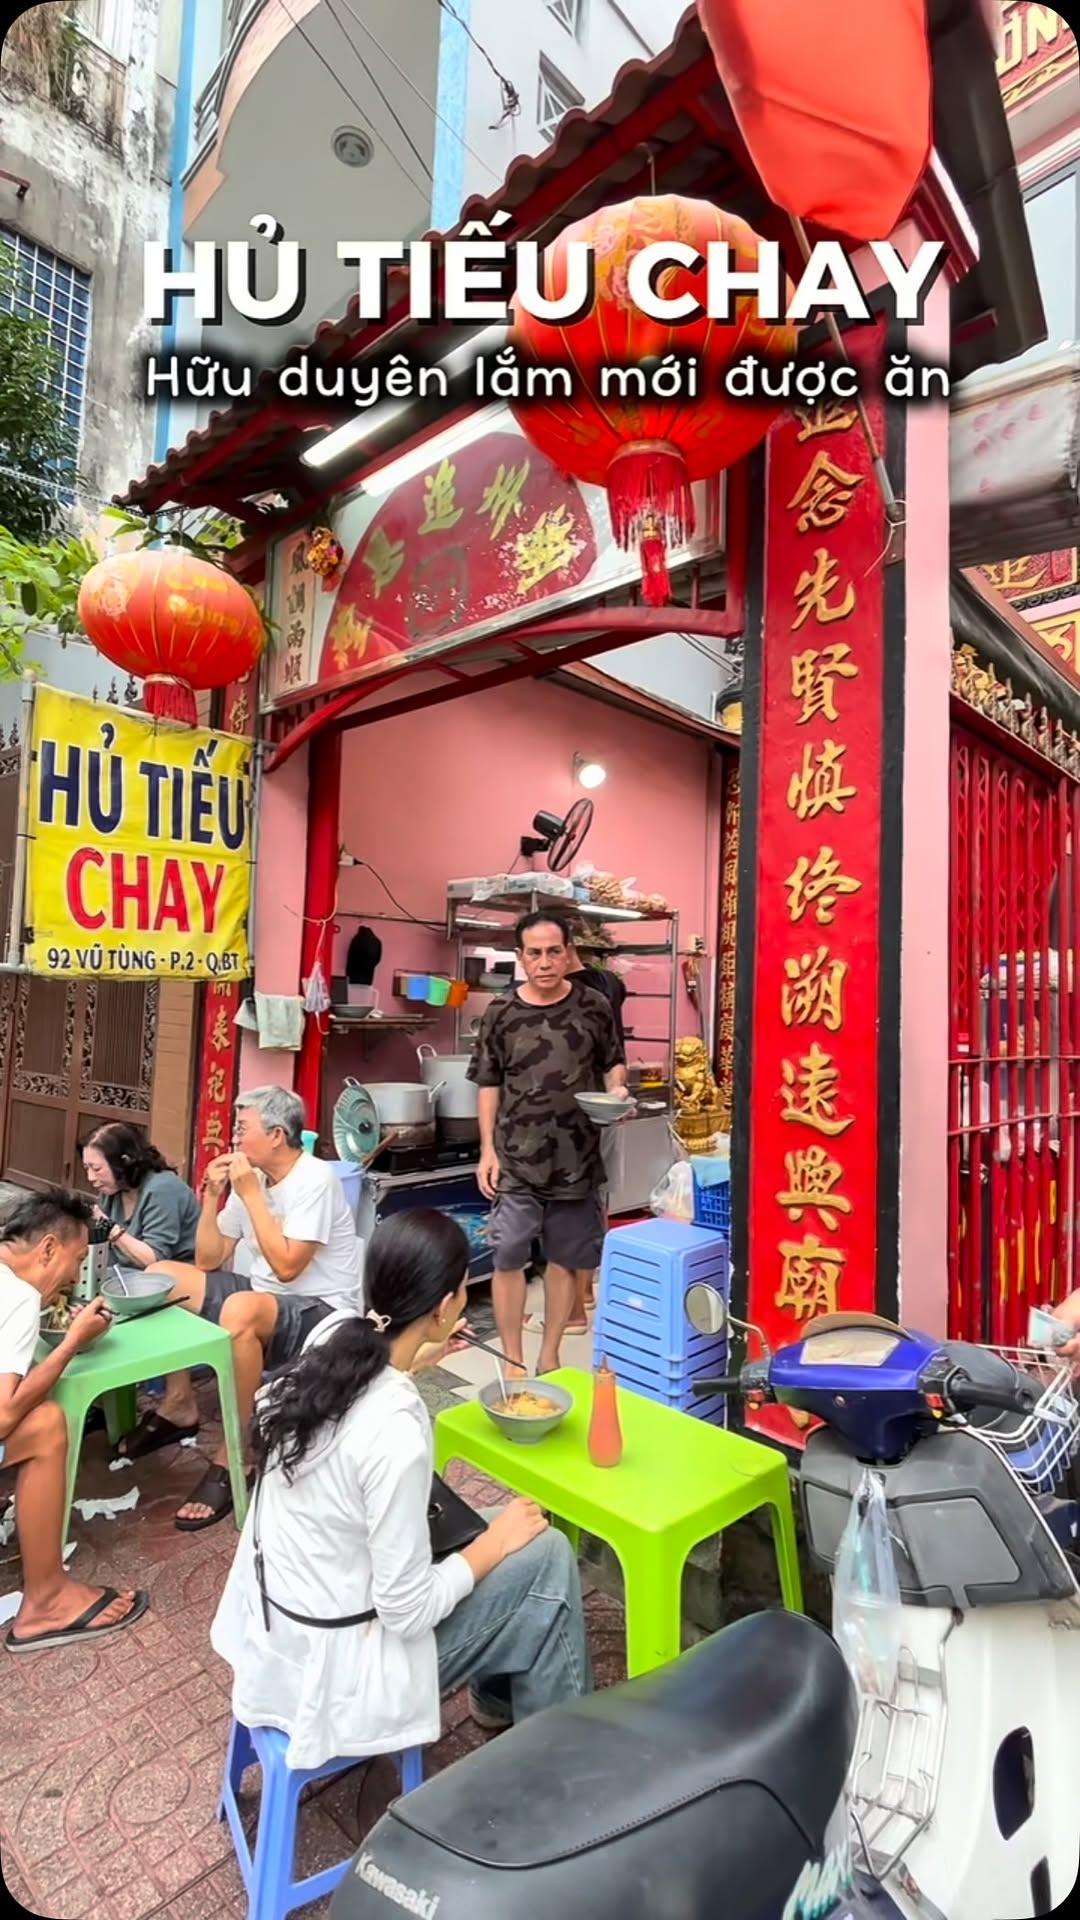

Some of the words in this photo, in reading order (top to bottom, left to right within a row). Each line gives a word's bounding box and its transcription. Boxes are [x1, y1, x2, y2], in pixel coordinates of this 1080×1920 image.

[39, 722, 123, 834] HỦ
[139, 739, 246, 850] TIẾU
[66, 846, 226, 934] CHAY
[774, 398, 865, 1428] 念先賢慎終溯遠興廟
[48, 947, 71, 970] 92
[76, 943, 104, 970] VŨ
[108, 944, 156, 971] TÙNG
